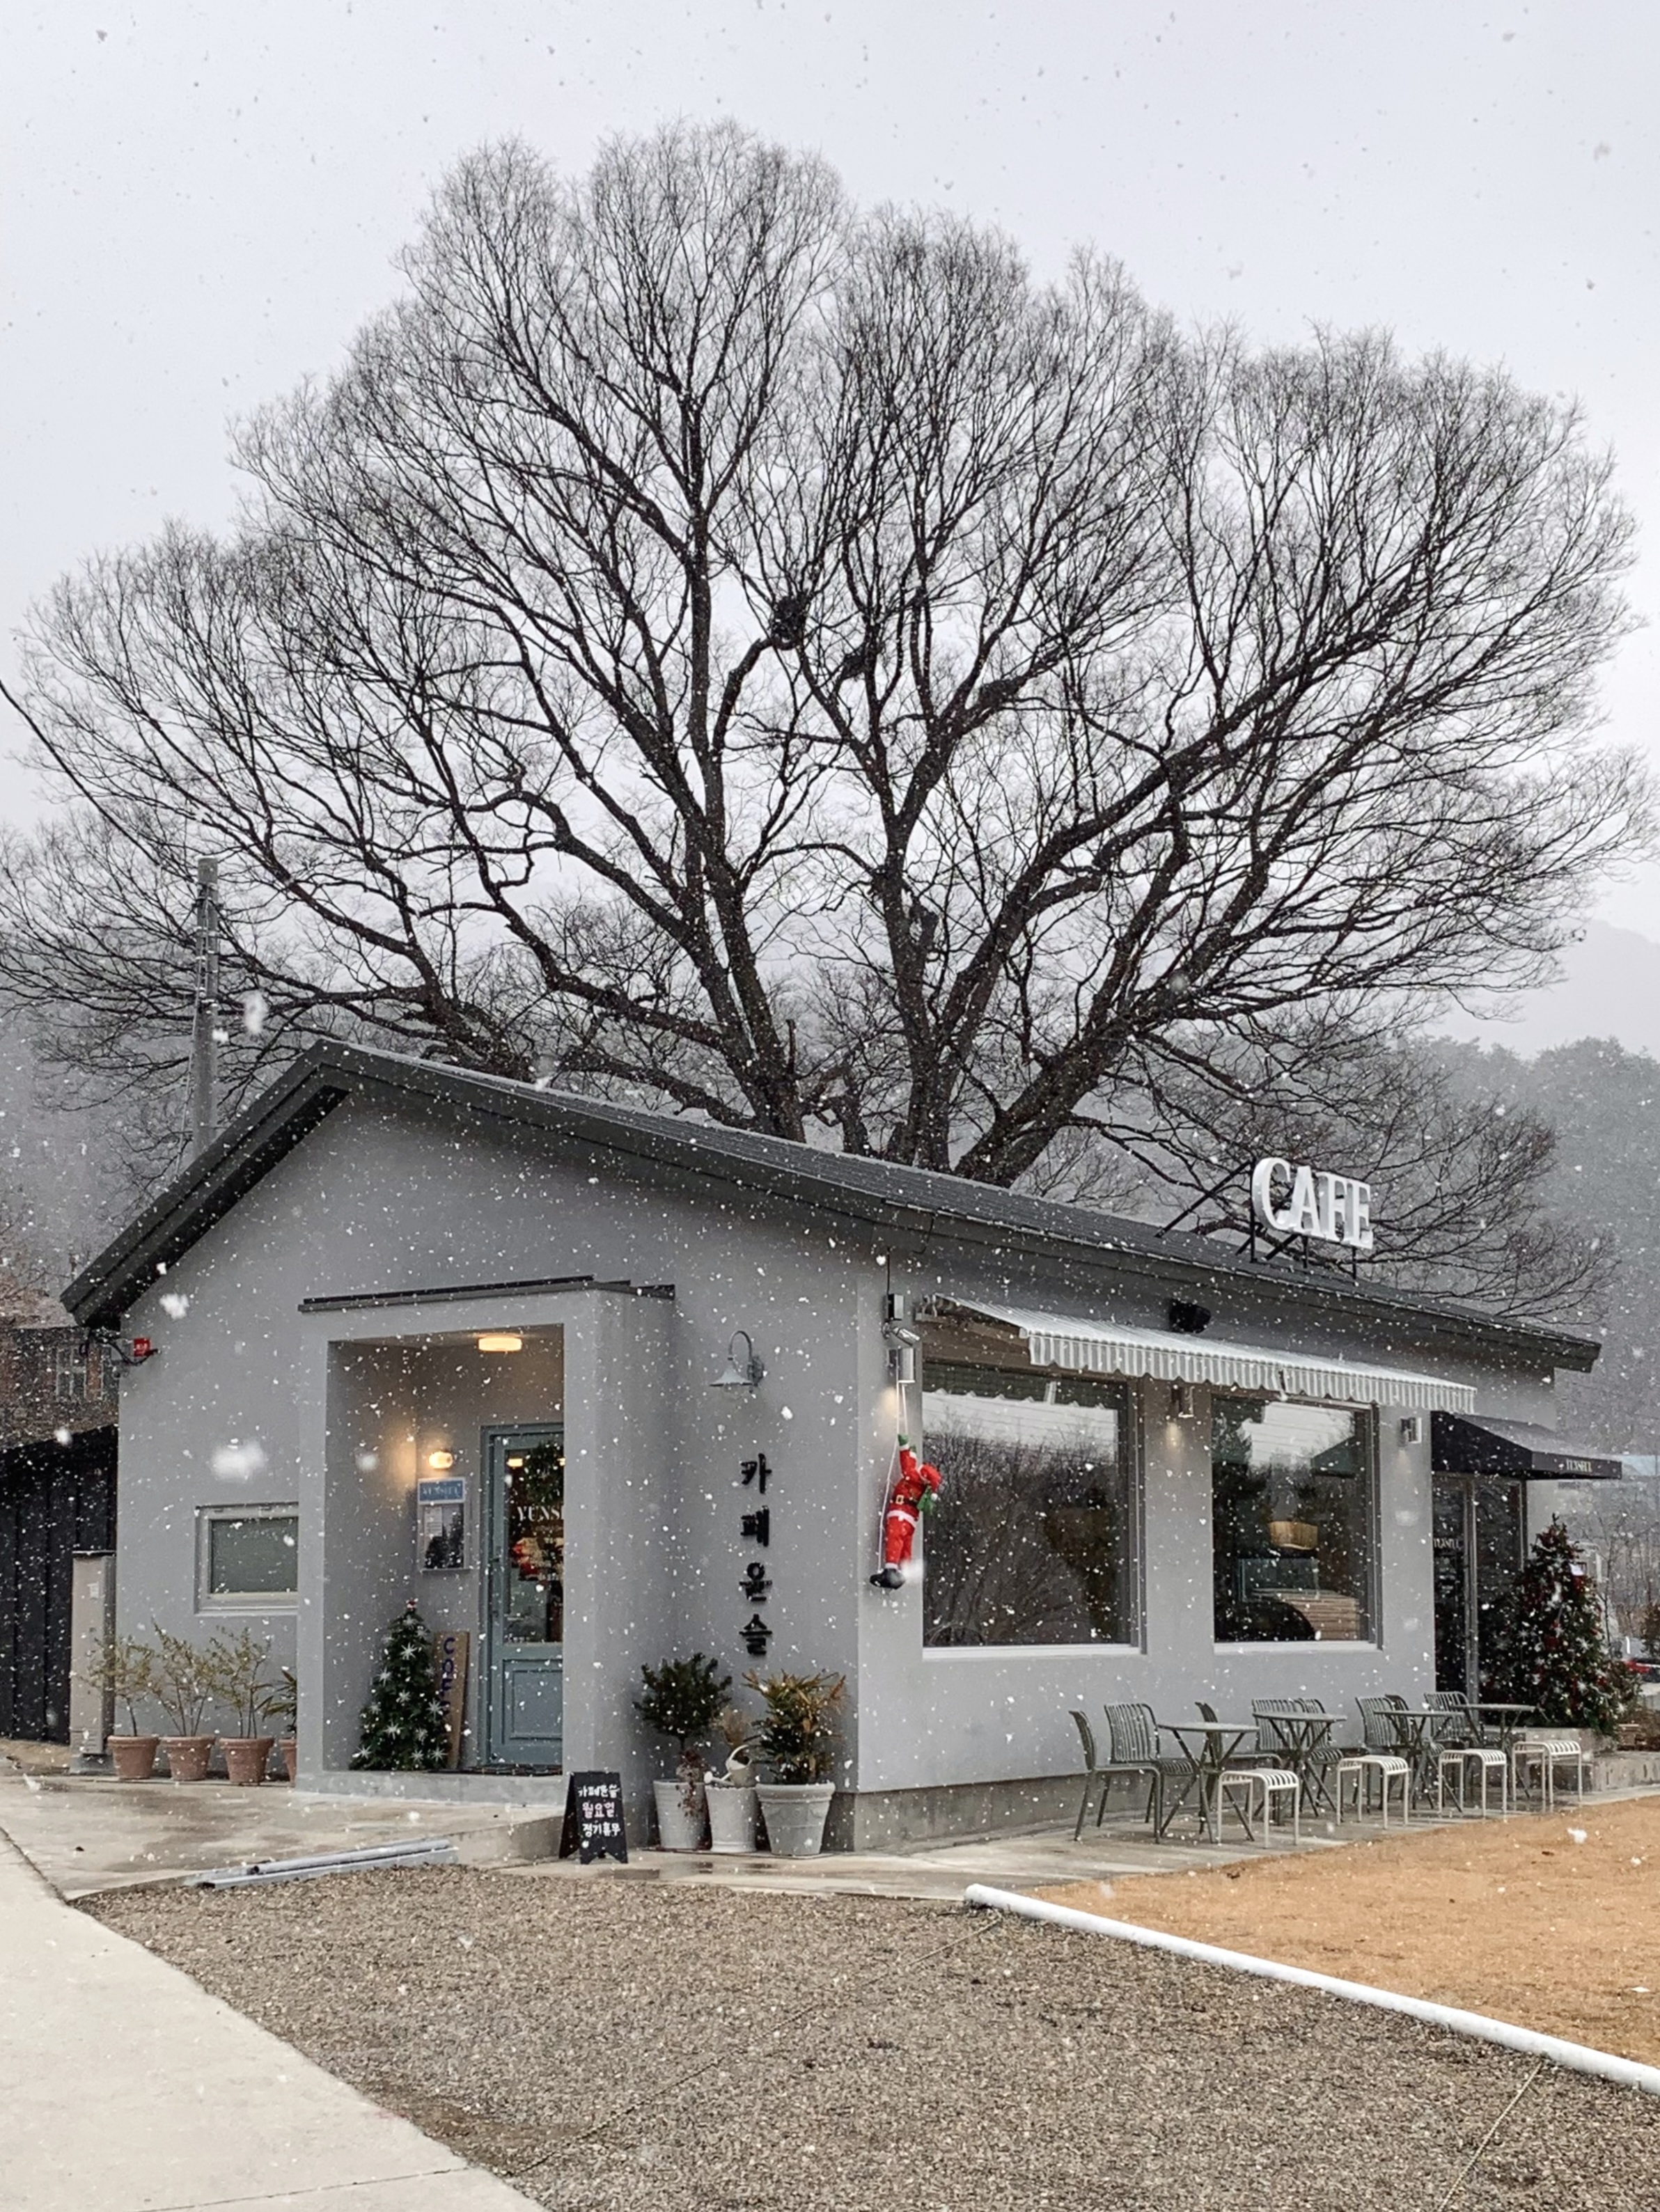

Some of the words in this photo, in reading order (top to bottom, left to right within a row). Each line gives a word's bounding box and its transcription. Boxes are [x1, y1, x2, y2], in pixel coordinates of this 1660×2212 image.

[1252, 1157, 1373, 1249] CAFE
[517, 1506, 564, 1523] YUNS
[582, 1802, 615, 1819] 월요일
[582, 1821, 621, 1838] 정기휴무
